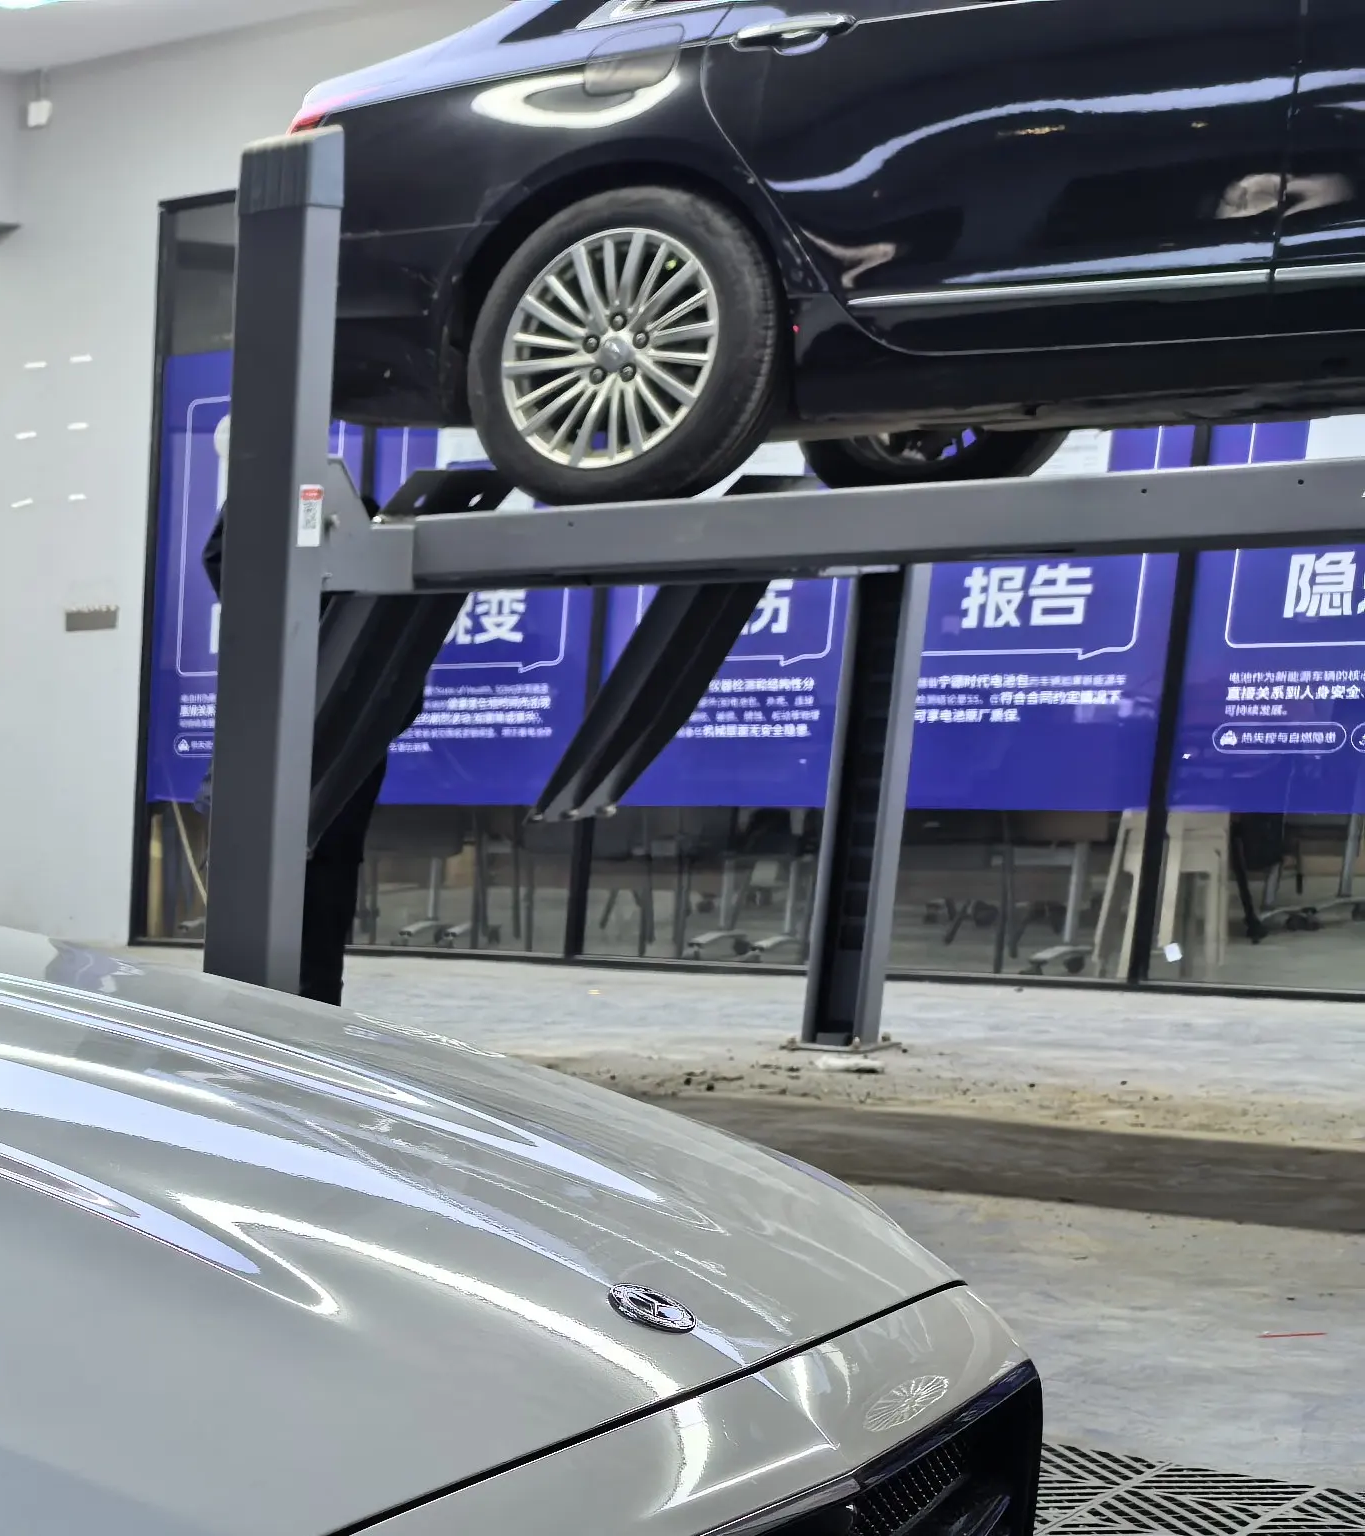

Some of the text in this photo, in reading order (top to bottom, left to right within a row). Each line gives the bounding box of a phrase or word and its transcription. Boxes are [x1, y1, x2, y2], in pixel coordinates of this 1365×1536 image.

[961, 563, 1093, 629] 报告
[1283, 551, 1365, 618] 隐
[1229, 669, 1365, 683] 电池作为新能源车辆的核
